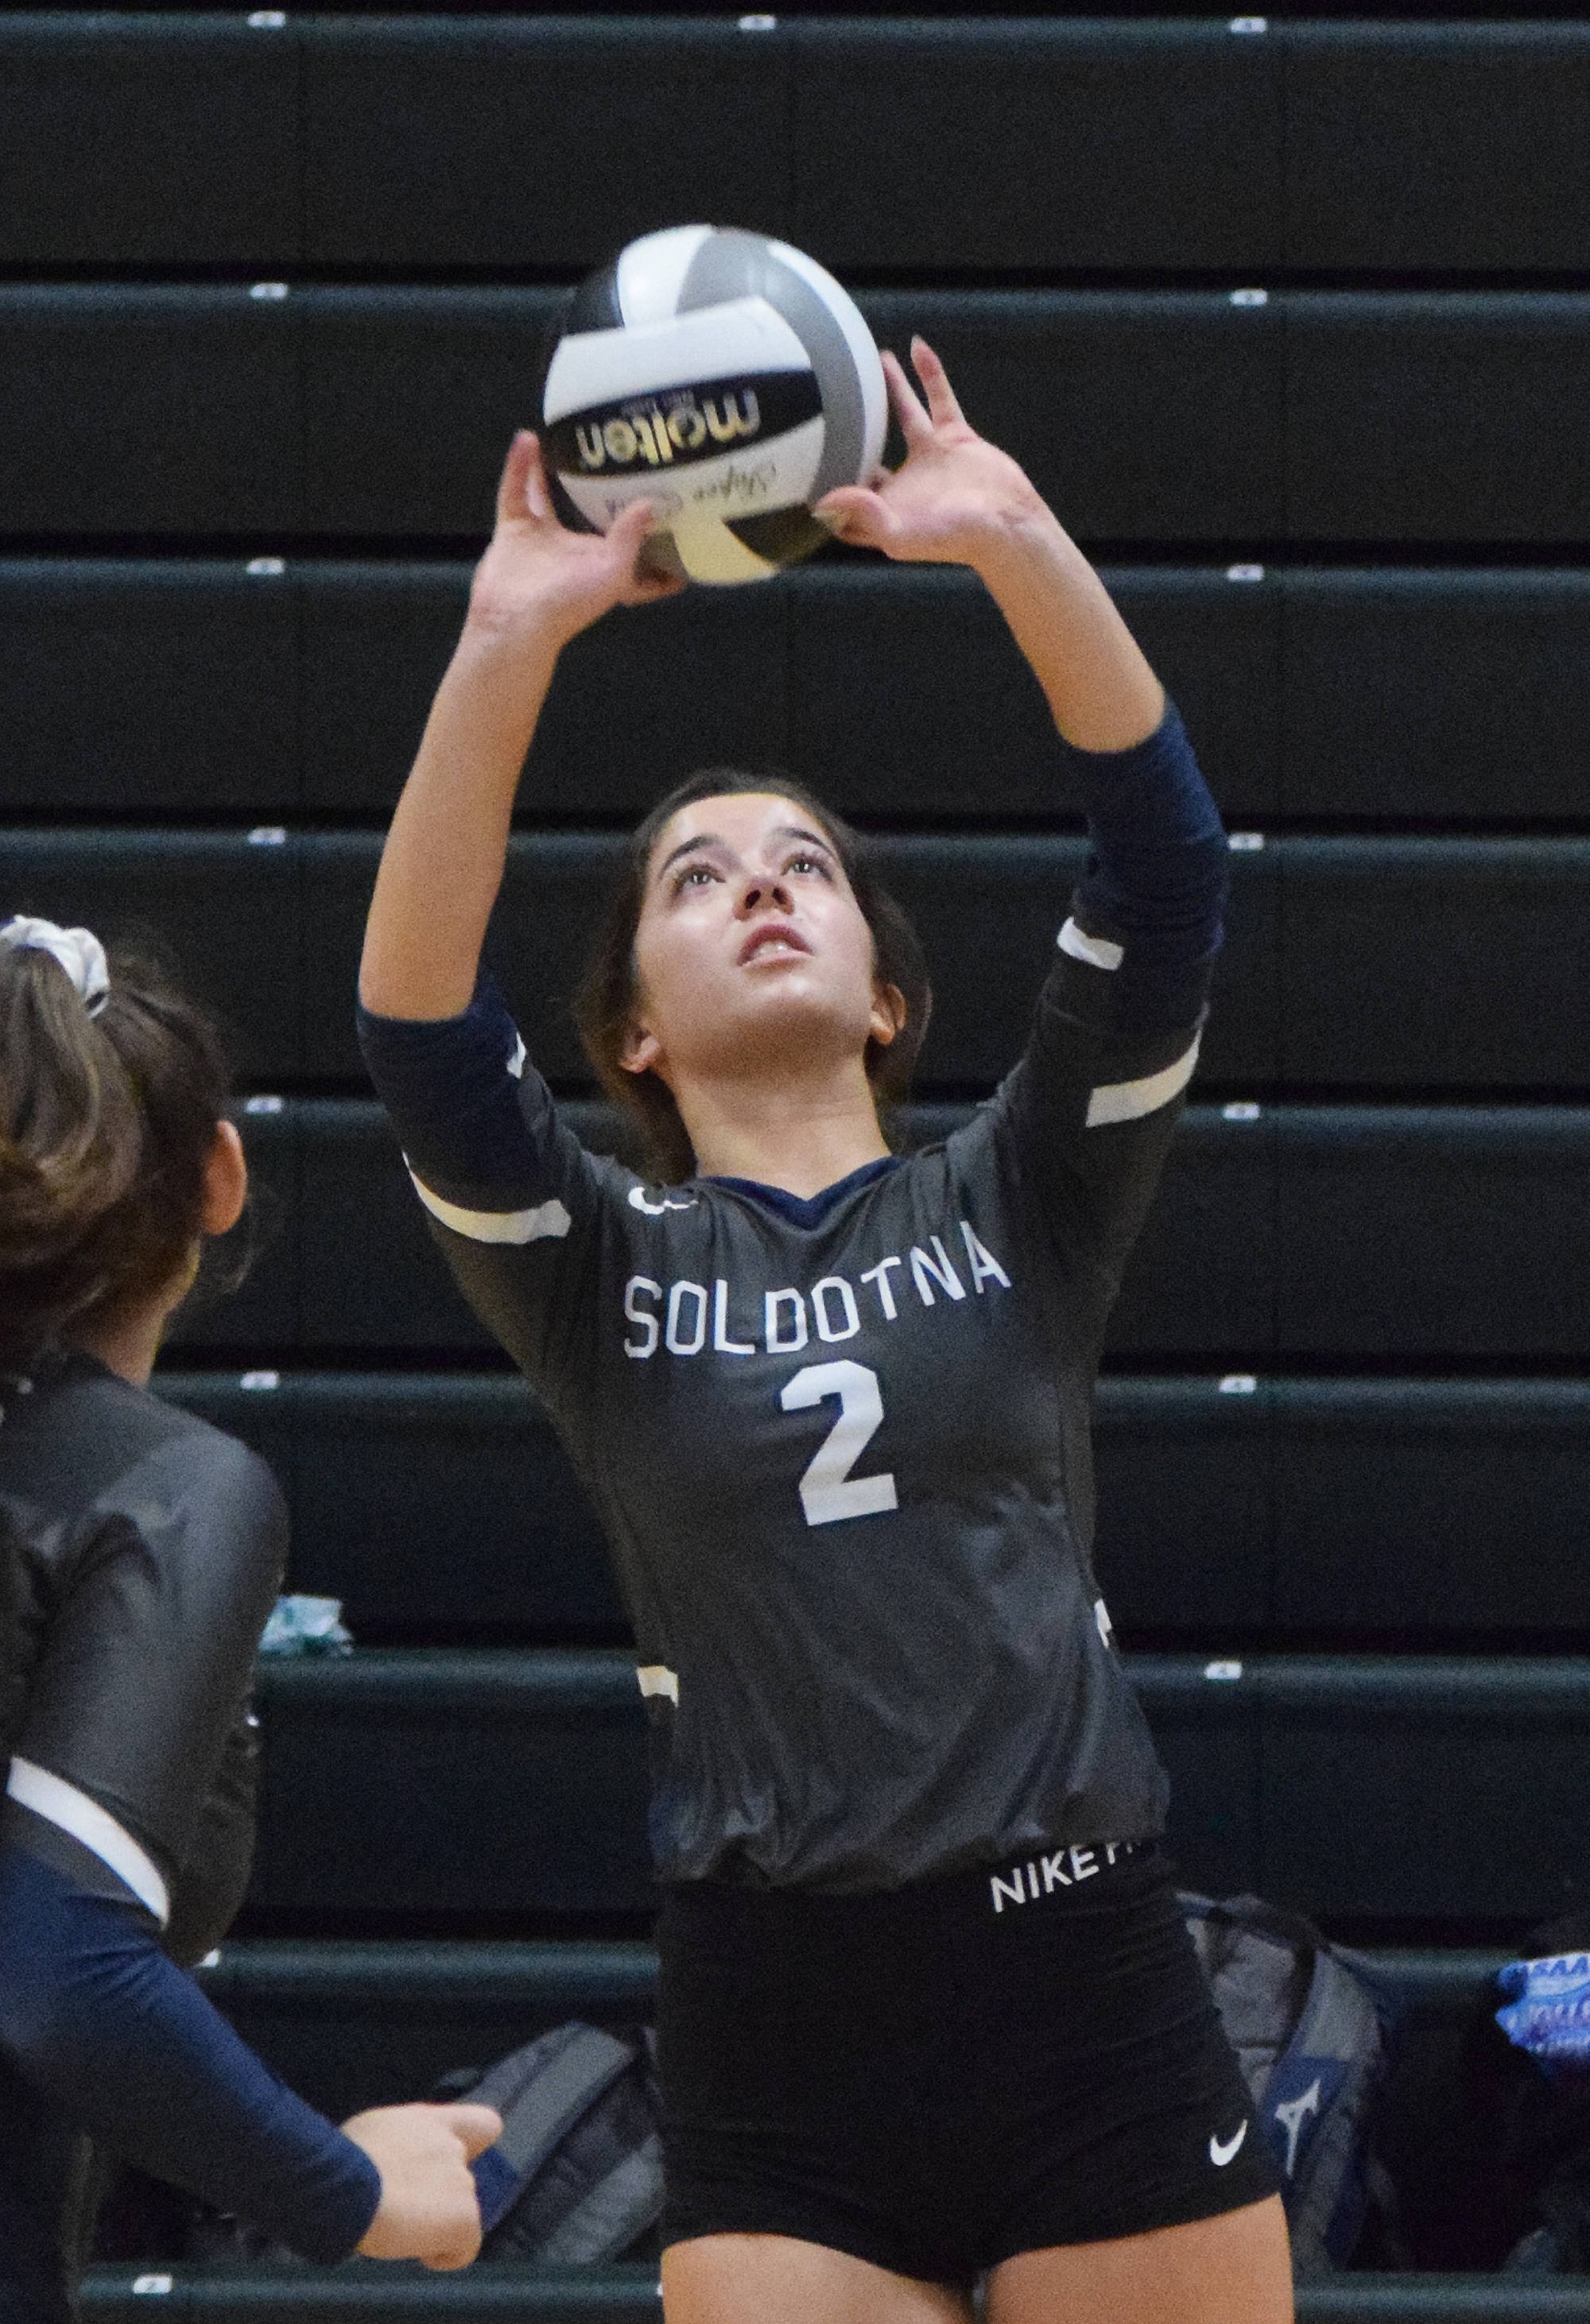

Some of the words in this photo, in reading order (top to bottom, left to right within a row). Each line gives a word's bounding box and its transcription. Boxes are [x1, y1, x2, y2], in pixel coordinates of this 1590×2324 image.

[575, 389, 760, 468] molten
[623, 1220, 1012, 1358] SOLDOTNA
[780, 1359, 899, 1527] 2
[990, 1844, 1100, 1913] NIKE
